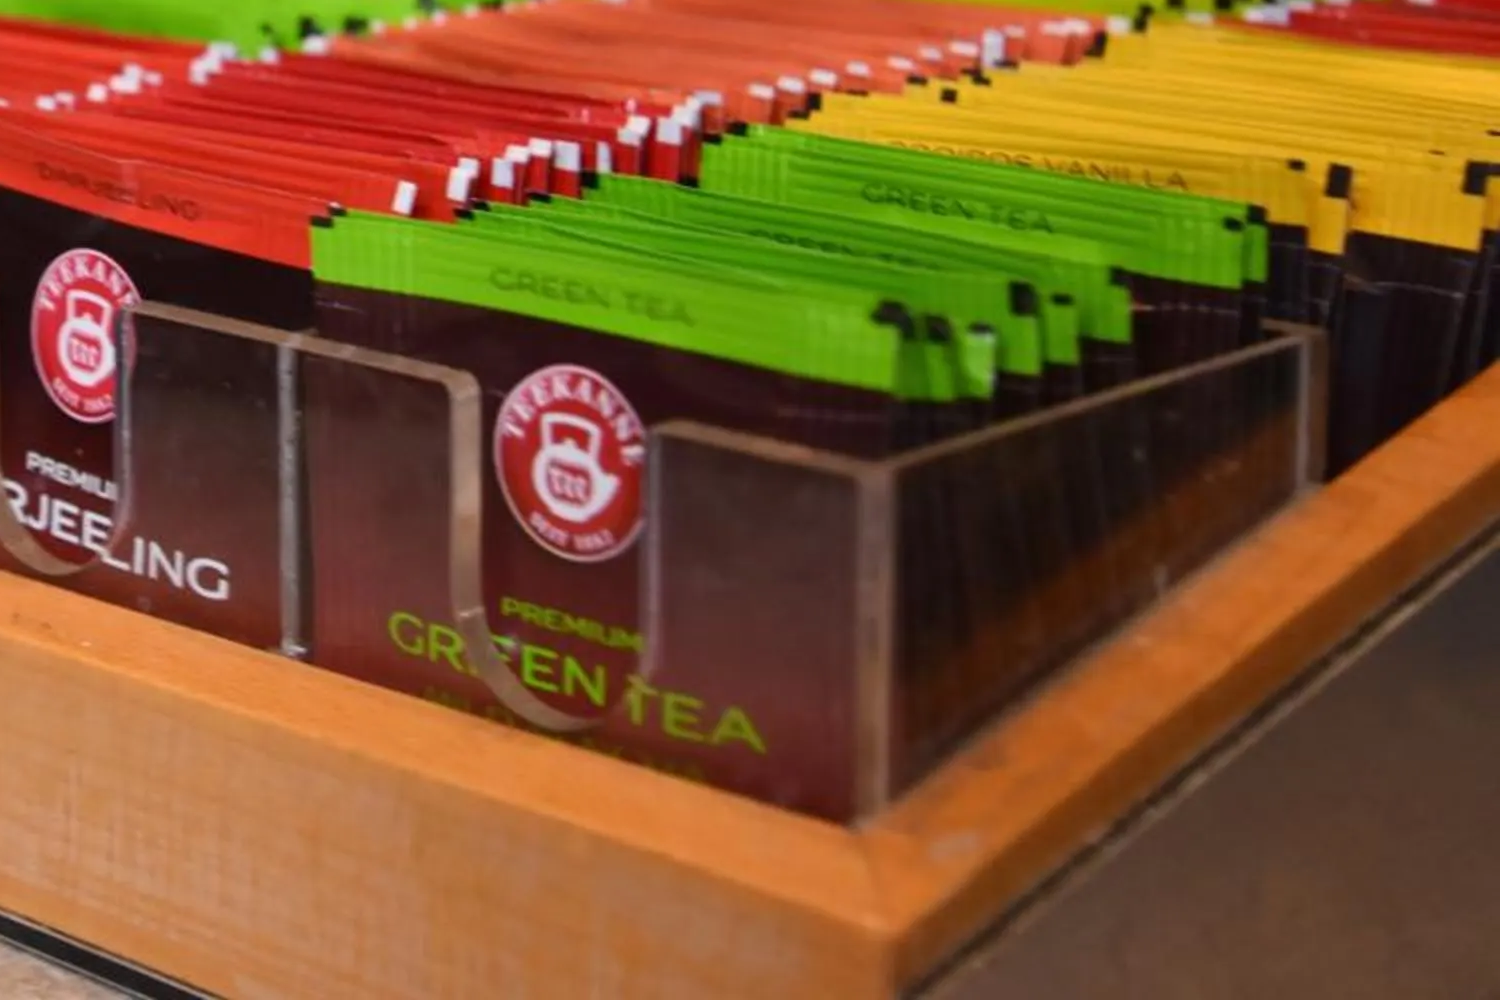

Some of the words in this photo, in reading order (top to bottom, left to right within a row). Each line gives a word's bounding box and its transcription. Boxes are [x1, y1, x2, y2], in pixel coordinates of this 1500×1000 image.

[861, 180, 975, 221] GREEN
[986, 200, 1055, 233] TEA
[489, 265, 610, 310] GREEN
[621, 290, 696, 328] TEA
[502, 372, 644, 467] TEEKANNE
[25, 450, 119, 501] PREMIU
[502, 597, 644, 653] PREMIUM
[624, 672, 767, 755] TEA
